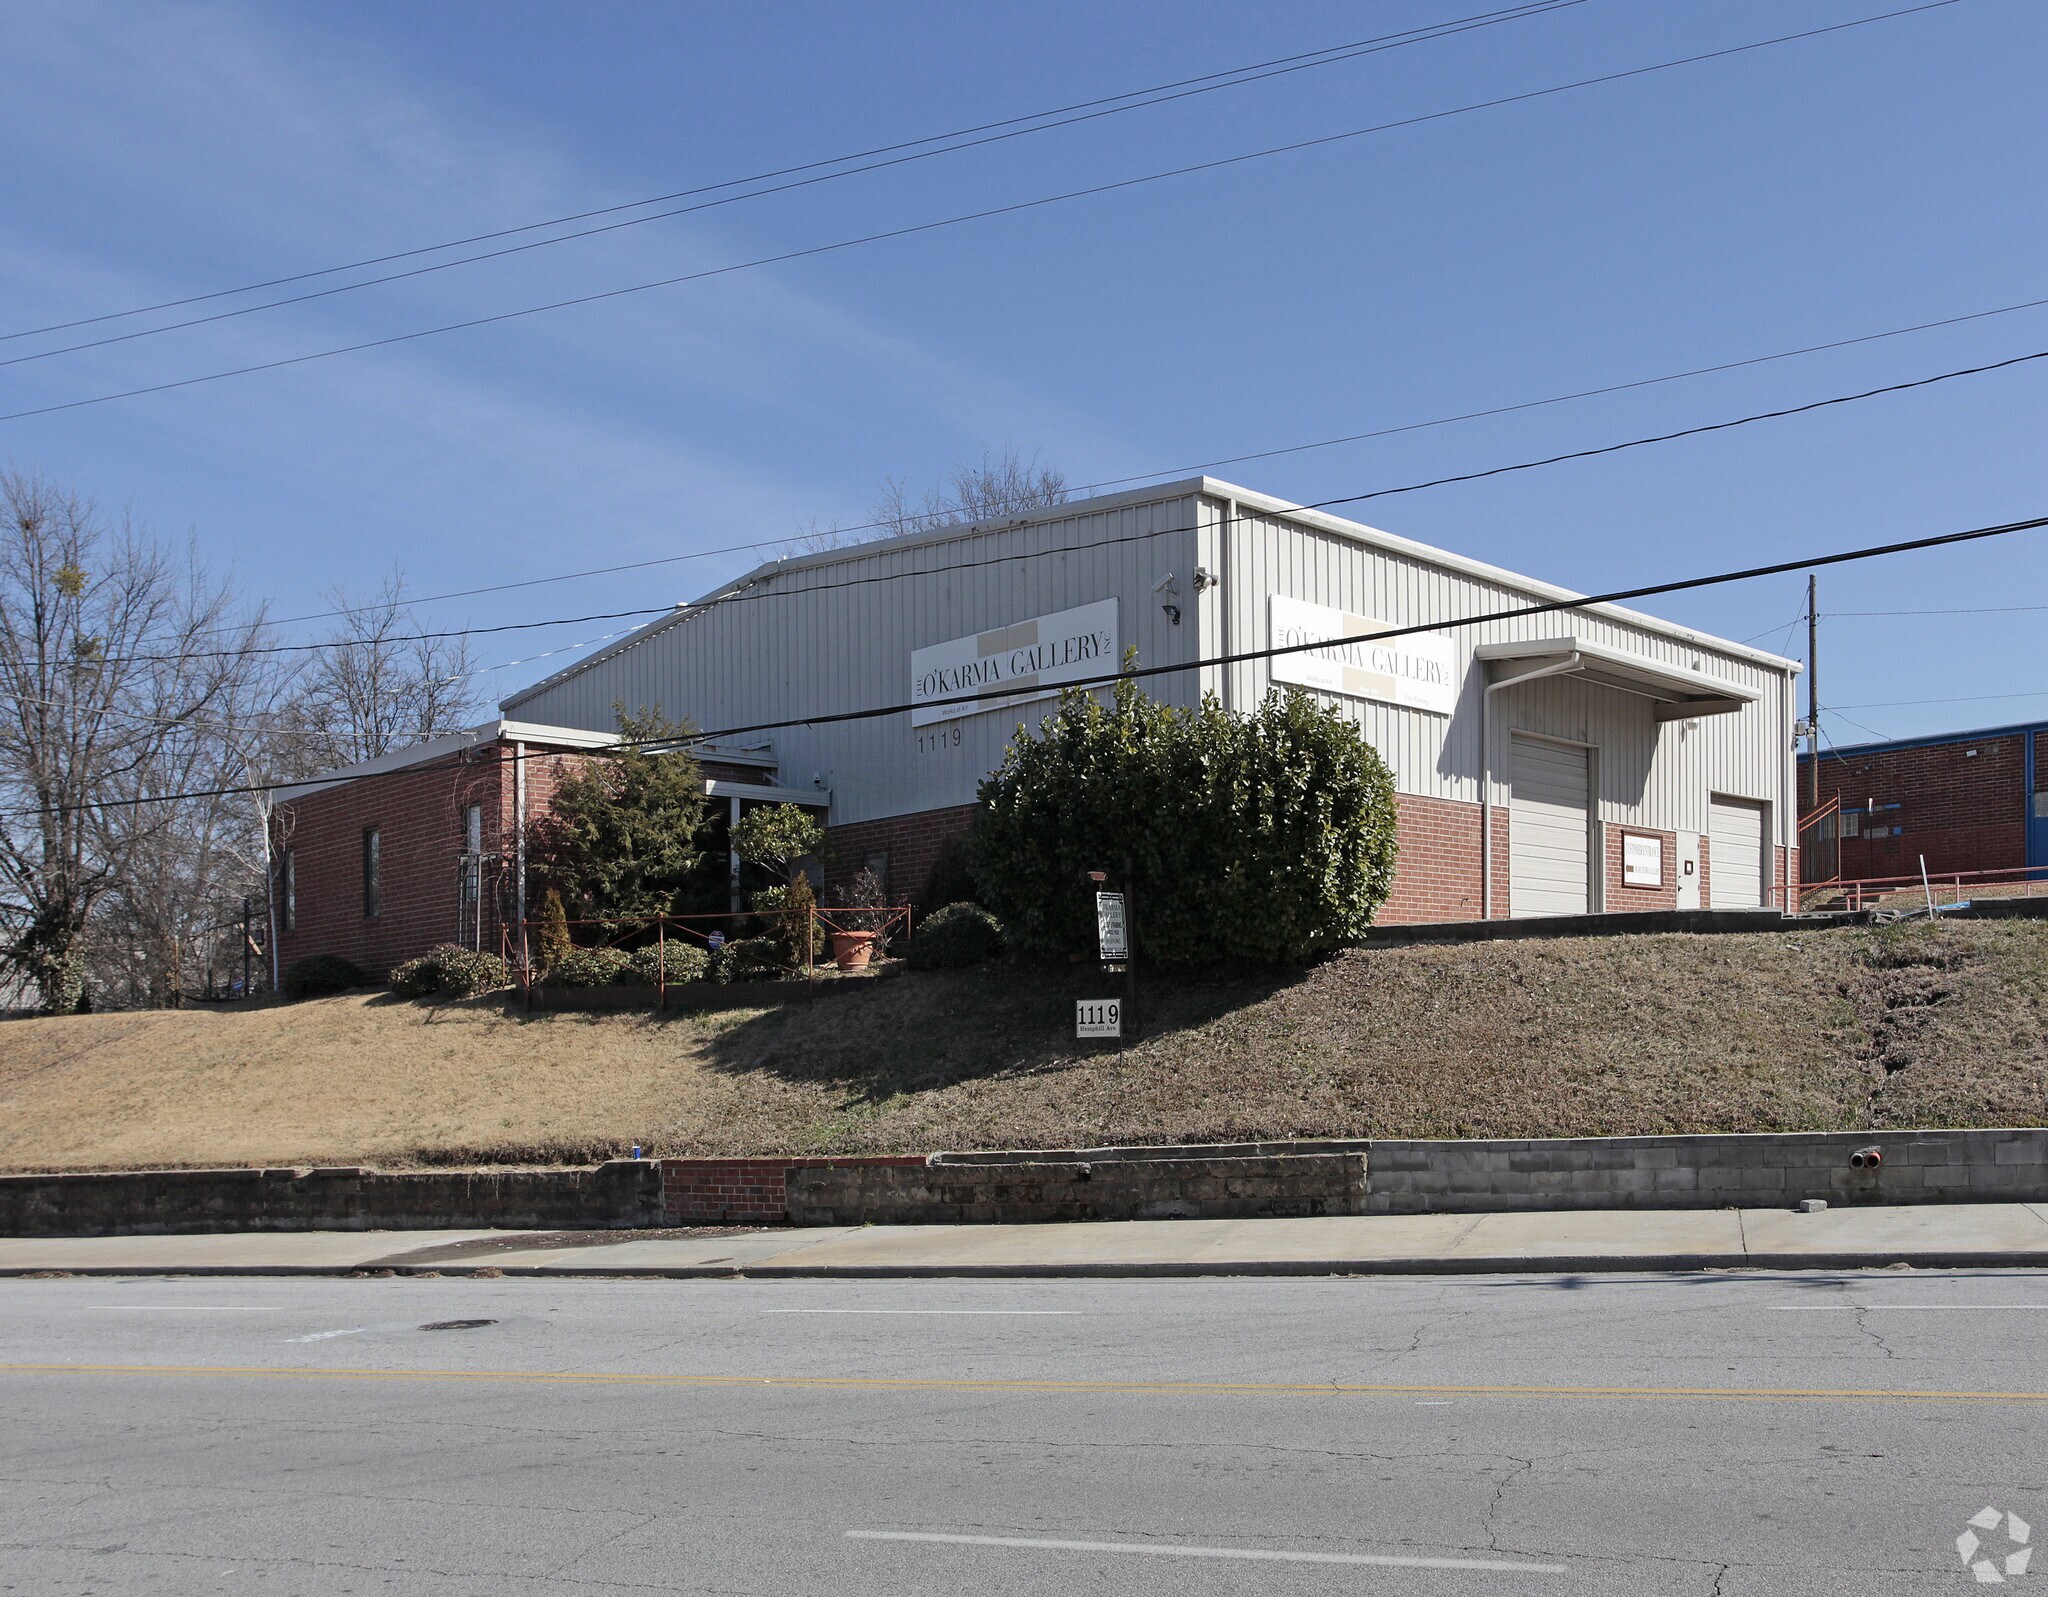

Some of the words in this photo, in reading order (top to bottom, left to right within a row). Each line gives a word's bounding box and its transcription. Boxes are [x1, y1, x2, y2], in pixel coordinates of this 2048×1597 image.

[923, 658, 1000, 697] O'KARMA
[1011, 631, 1104, 676] GALLERY
[1286, 625, 1364, 668] O'KARMA
[1371, 646, 1445, 685] GALLERY
[942, 708, 956, 716] Works
[961, 705, 969, 713] Art
[918, 728, 962, 754] 1119
[1078, 1004, 1119, 1025] 1119
[1079, 1025, 1105, 1034] Hemphill
[1106, 1024, 1118, 1033] Ave.
